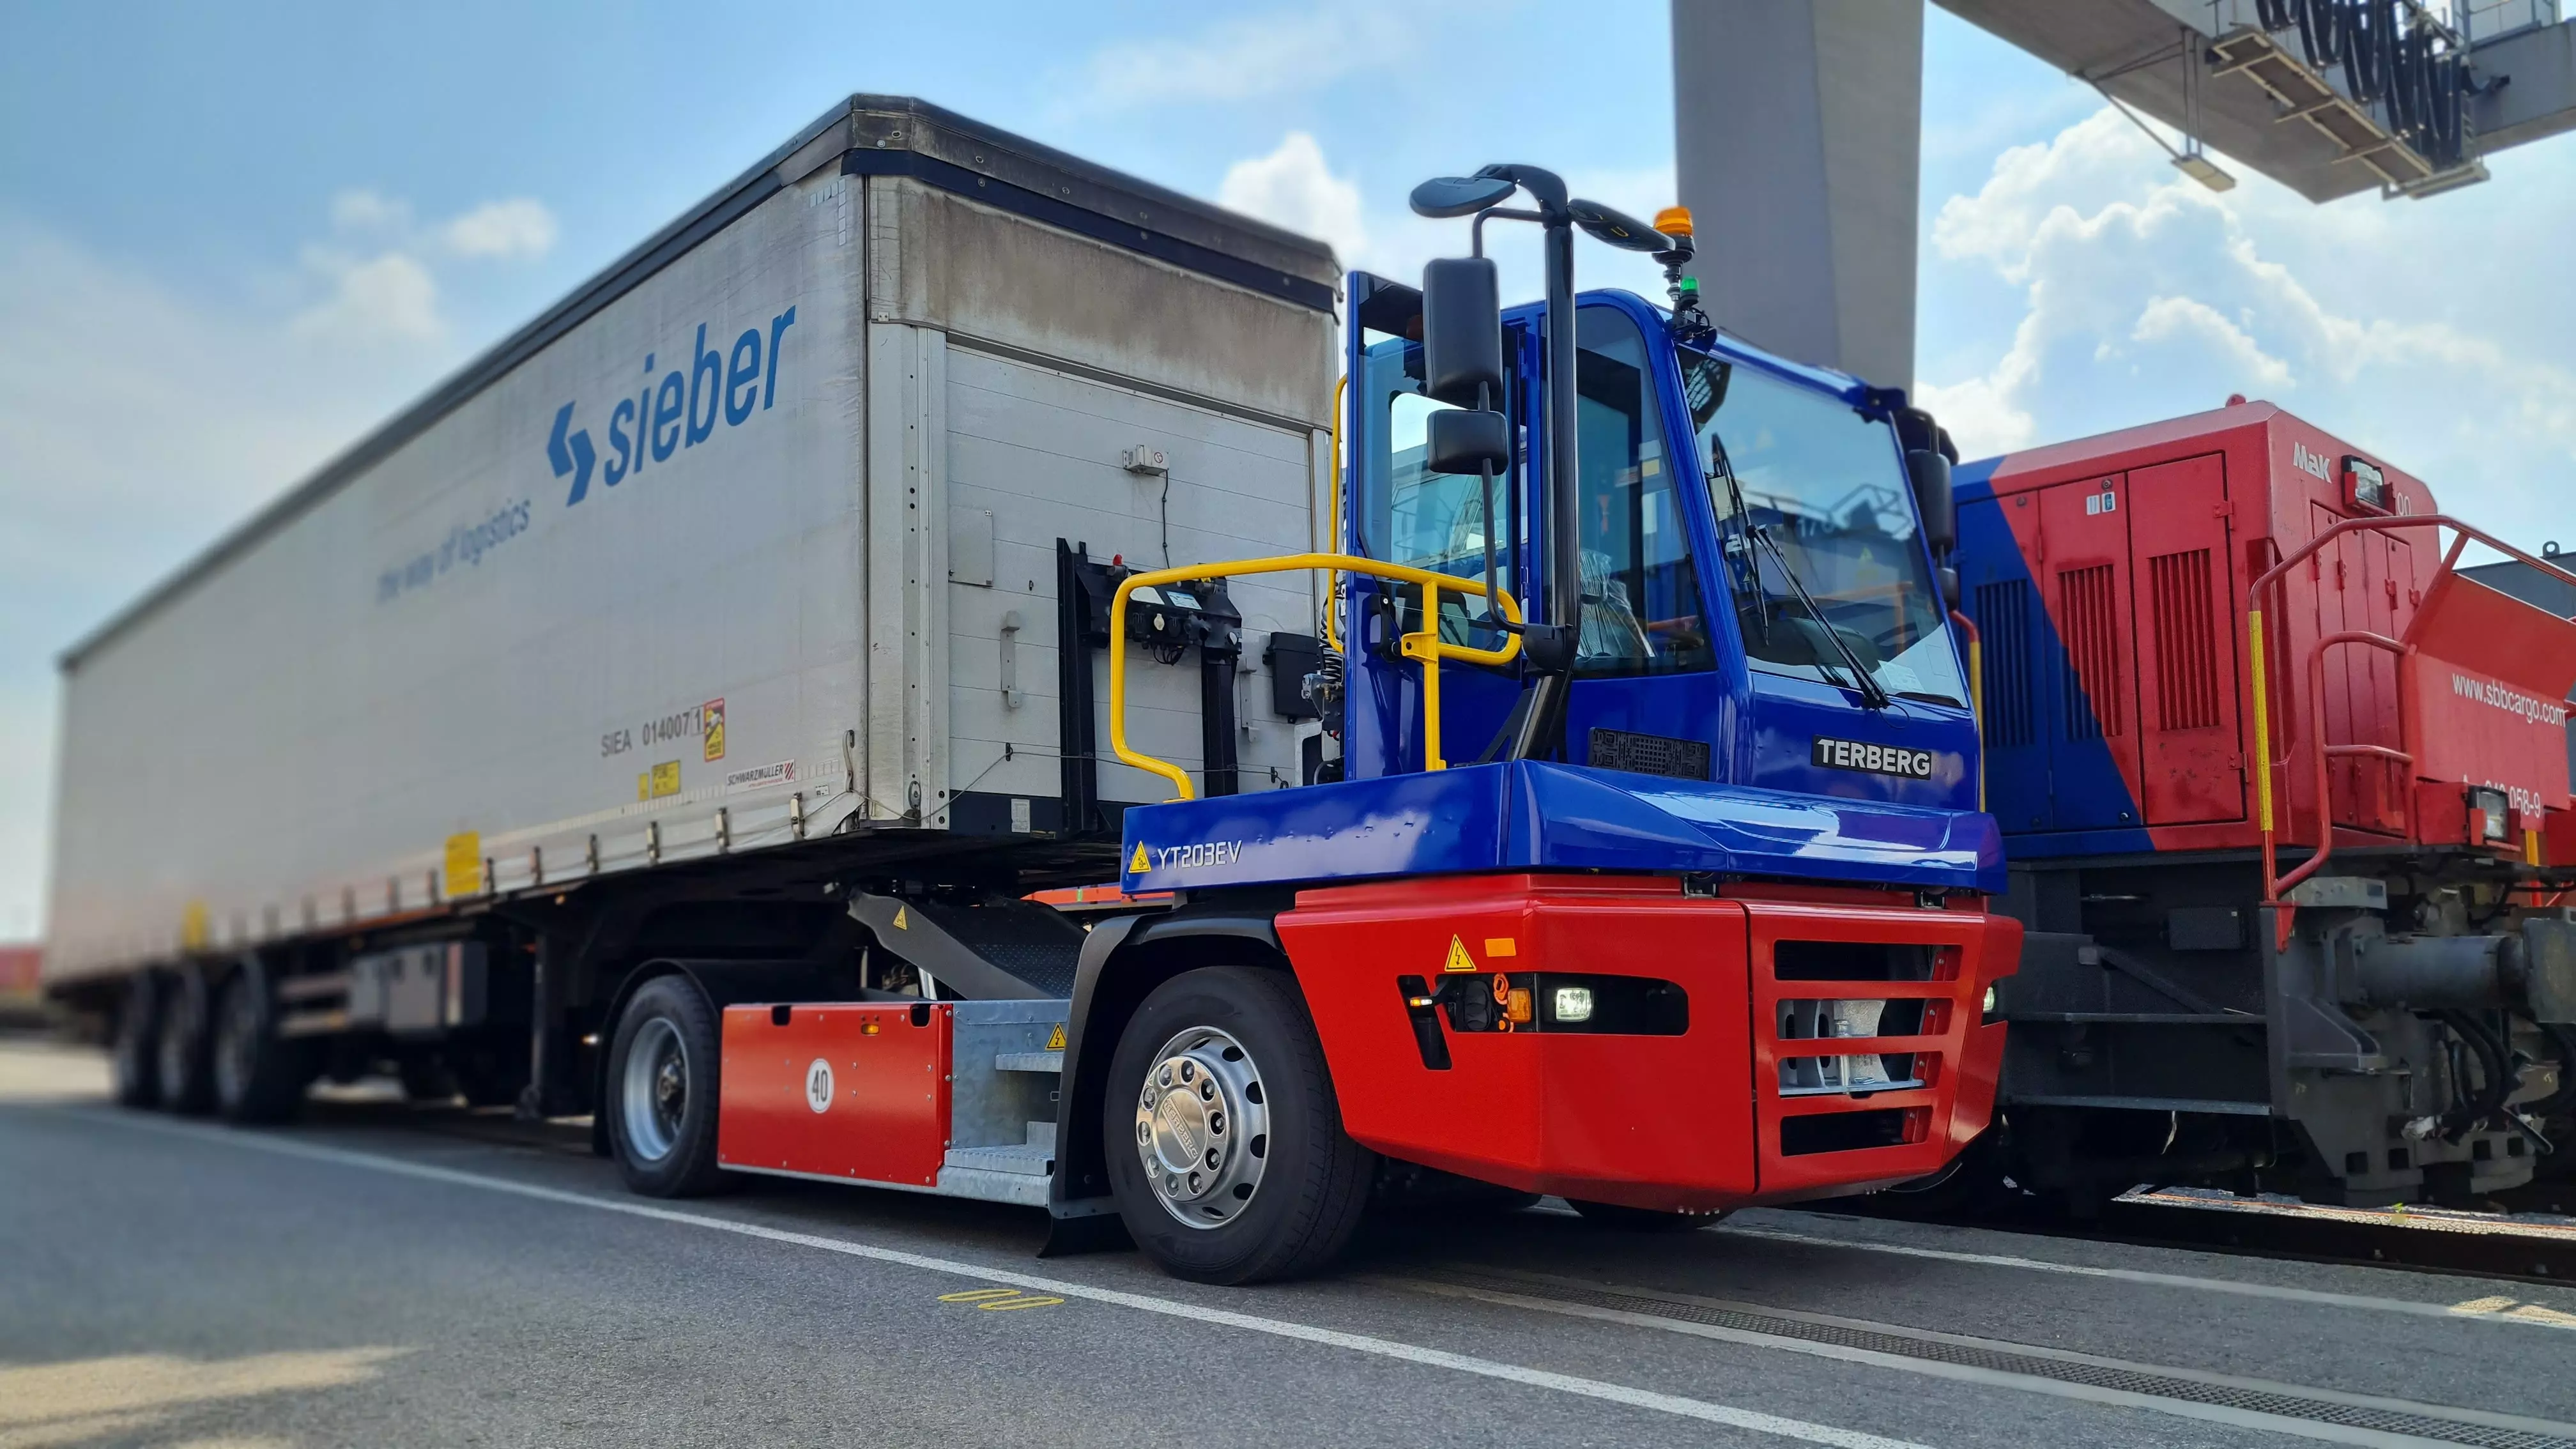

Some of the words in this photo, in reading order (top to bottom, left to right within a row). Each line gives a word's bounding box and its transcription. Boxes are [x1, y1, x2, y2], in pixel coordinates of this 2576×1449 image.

[604, 305, 796, 487] sieber
[2293, 441, 2332, 484] MaK
[2452, 673, 2566, 728] www.sbbcargo.com
[727, 763, 784, 786] SCHWARZMÜLLER
[1817, 739, 1930, 776] TERBERG
[1157, 839, 1242, 870] YT203EV
[812, 1069, 828, 1103] 40
[1164, 1101, 1199, 1160] TERBERG
